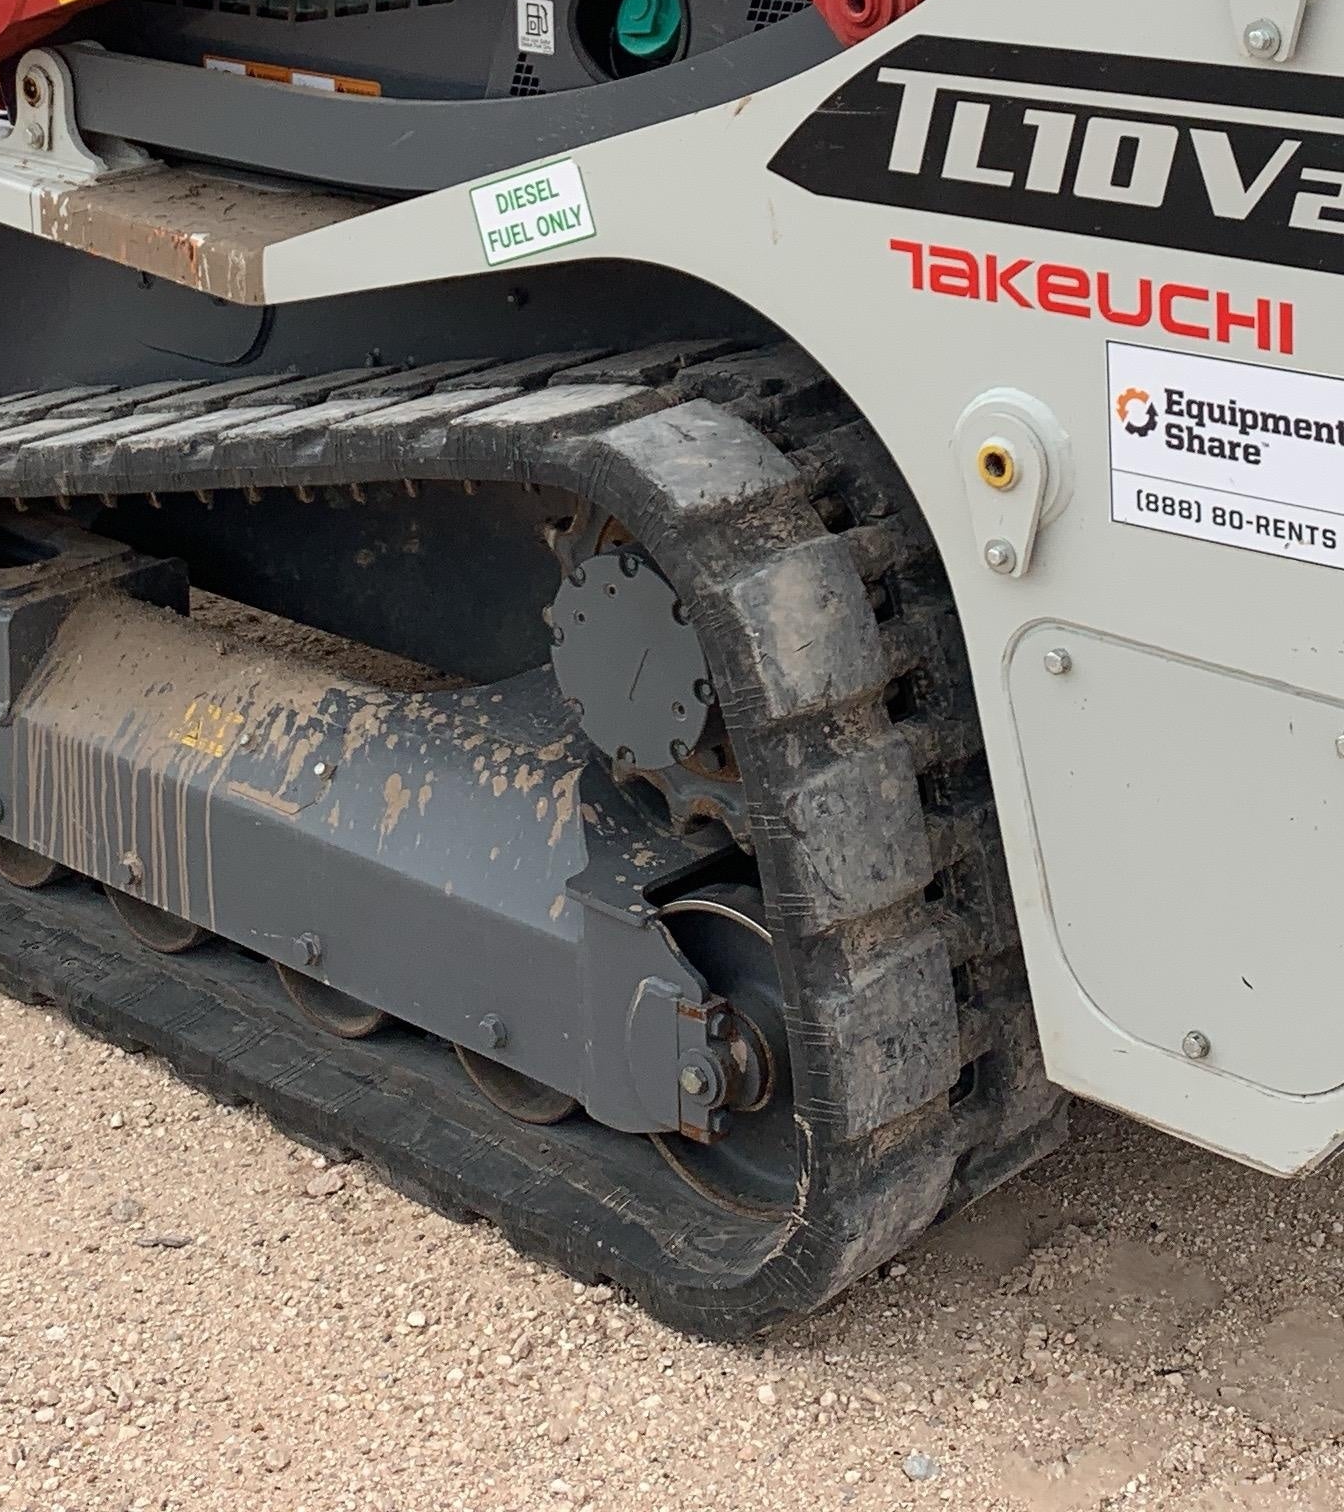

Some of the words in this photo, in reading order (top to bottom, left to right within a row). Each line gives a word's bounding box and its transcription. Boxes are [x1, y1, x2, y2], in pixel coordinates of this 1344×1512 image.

[495, 178, 560, 215] DIESEL
[487, 222, 534, 252] FUEL
[536, 204, 582, 237] ONLY
[1165, 422, 1262, 466] Share
[1136, 489, 1202, 523] (888)
[1211, 506, 1337, 550] 80-RENTS
